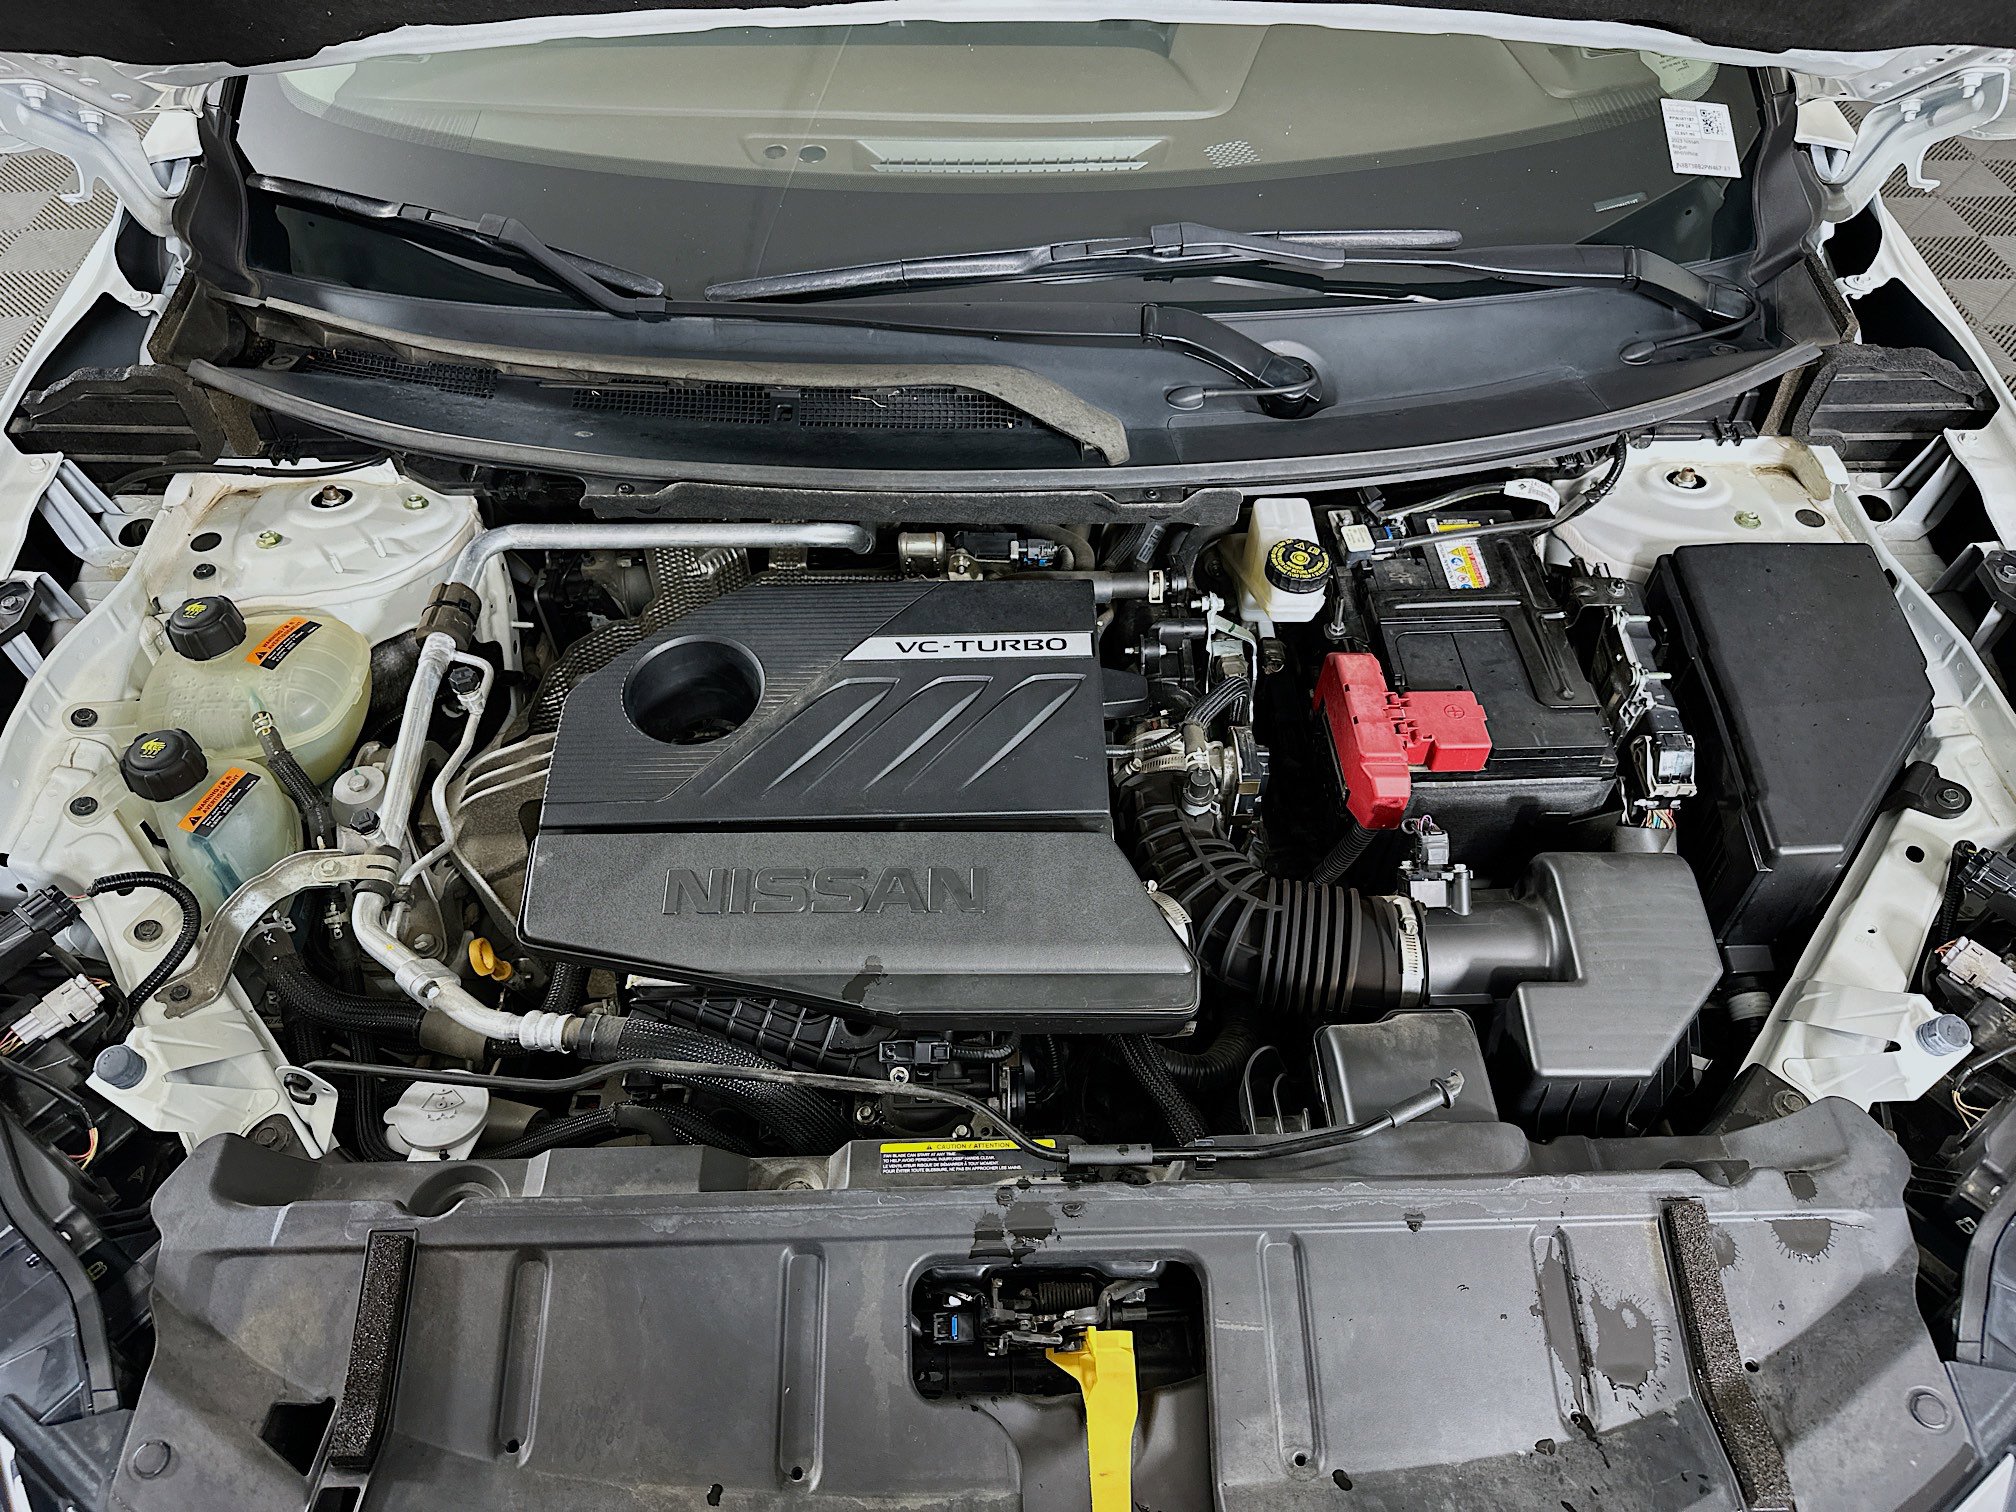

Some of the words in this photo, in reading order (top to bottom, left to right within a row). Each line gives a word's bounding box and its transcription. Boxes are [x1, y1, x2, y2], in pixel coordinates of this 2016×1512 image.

[894, 637, 1068, 654] VC-TURBO
[196, 787, 219, 811] WARNING
[202, 774, 239, 814] AVERTISSEMENT
[662, 867, 986, 914] NISSAN
